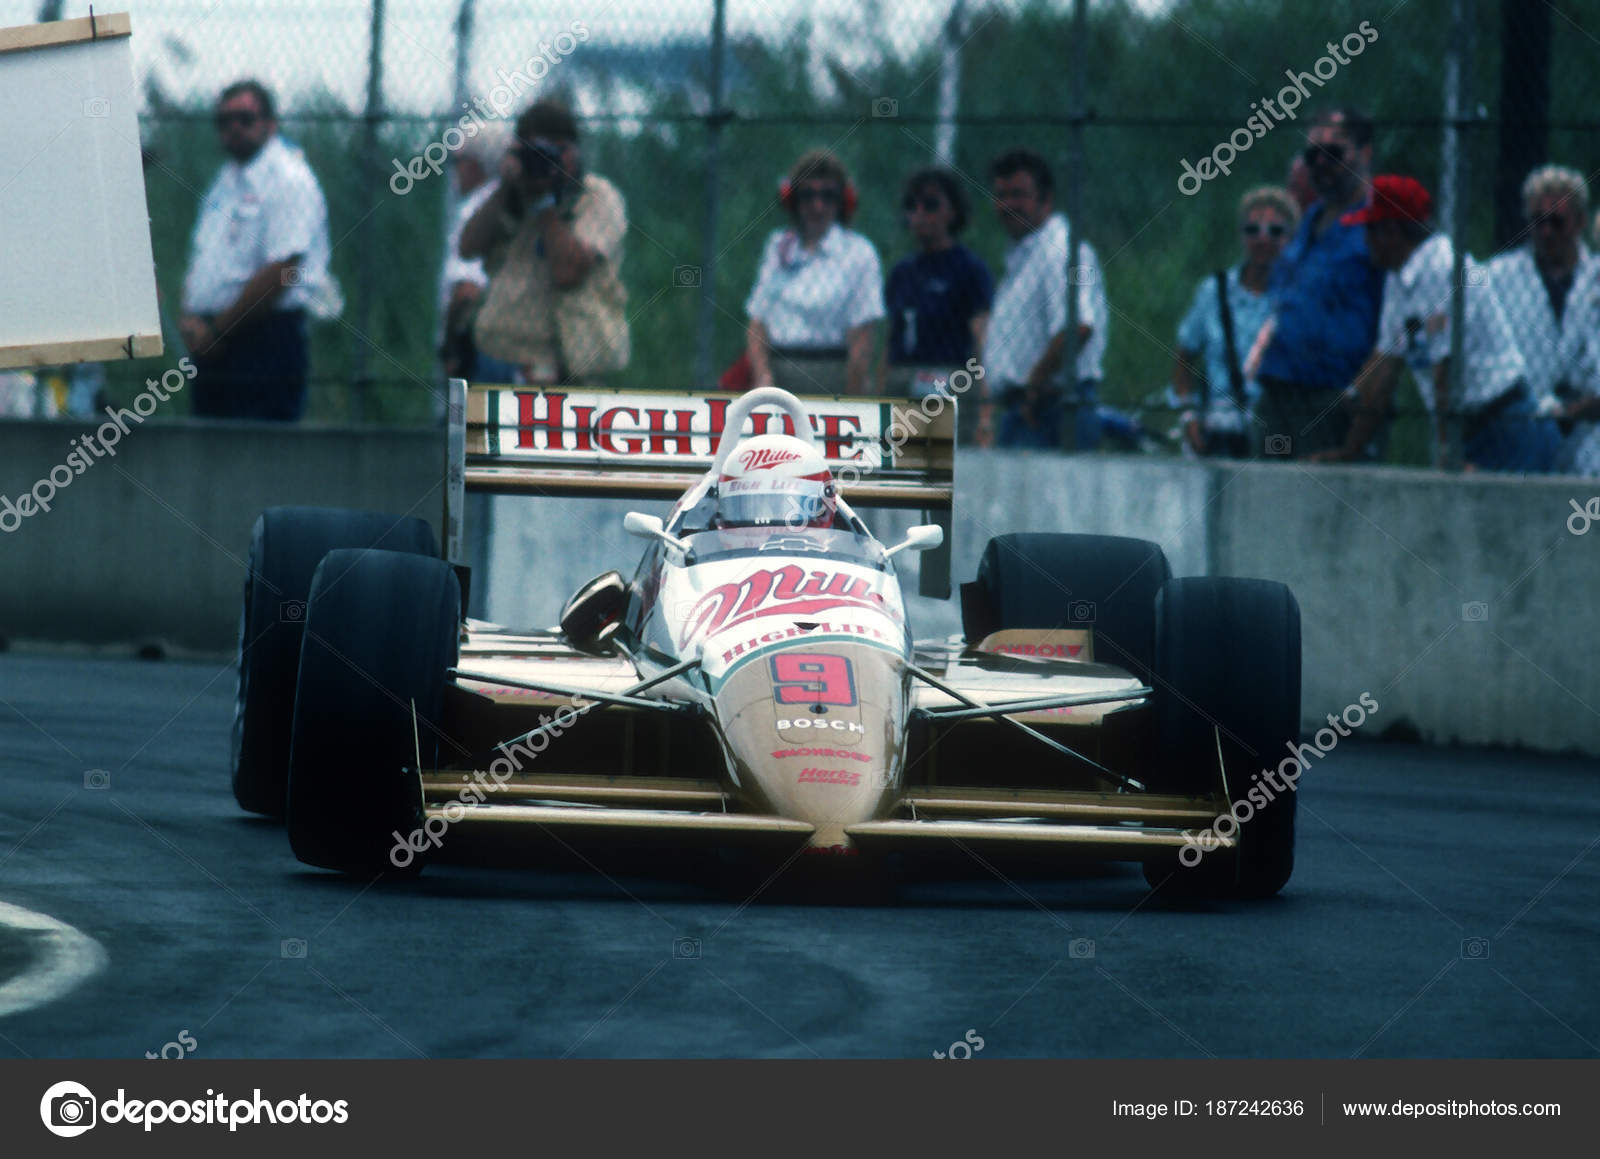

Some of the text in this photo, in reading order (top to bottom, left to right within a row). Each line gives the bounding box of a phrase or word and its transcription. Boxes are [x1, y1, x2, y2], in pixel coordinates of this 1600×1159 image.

[738, 448, 802, 473] Miller
[770, 653, 857, 706] 9
[776, 718, 865, 734] BOSCH
[799, 767, 862, 781] Hertz
